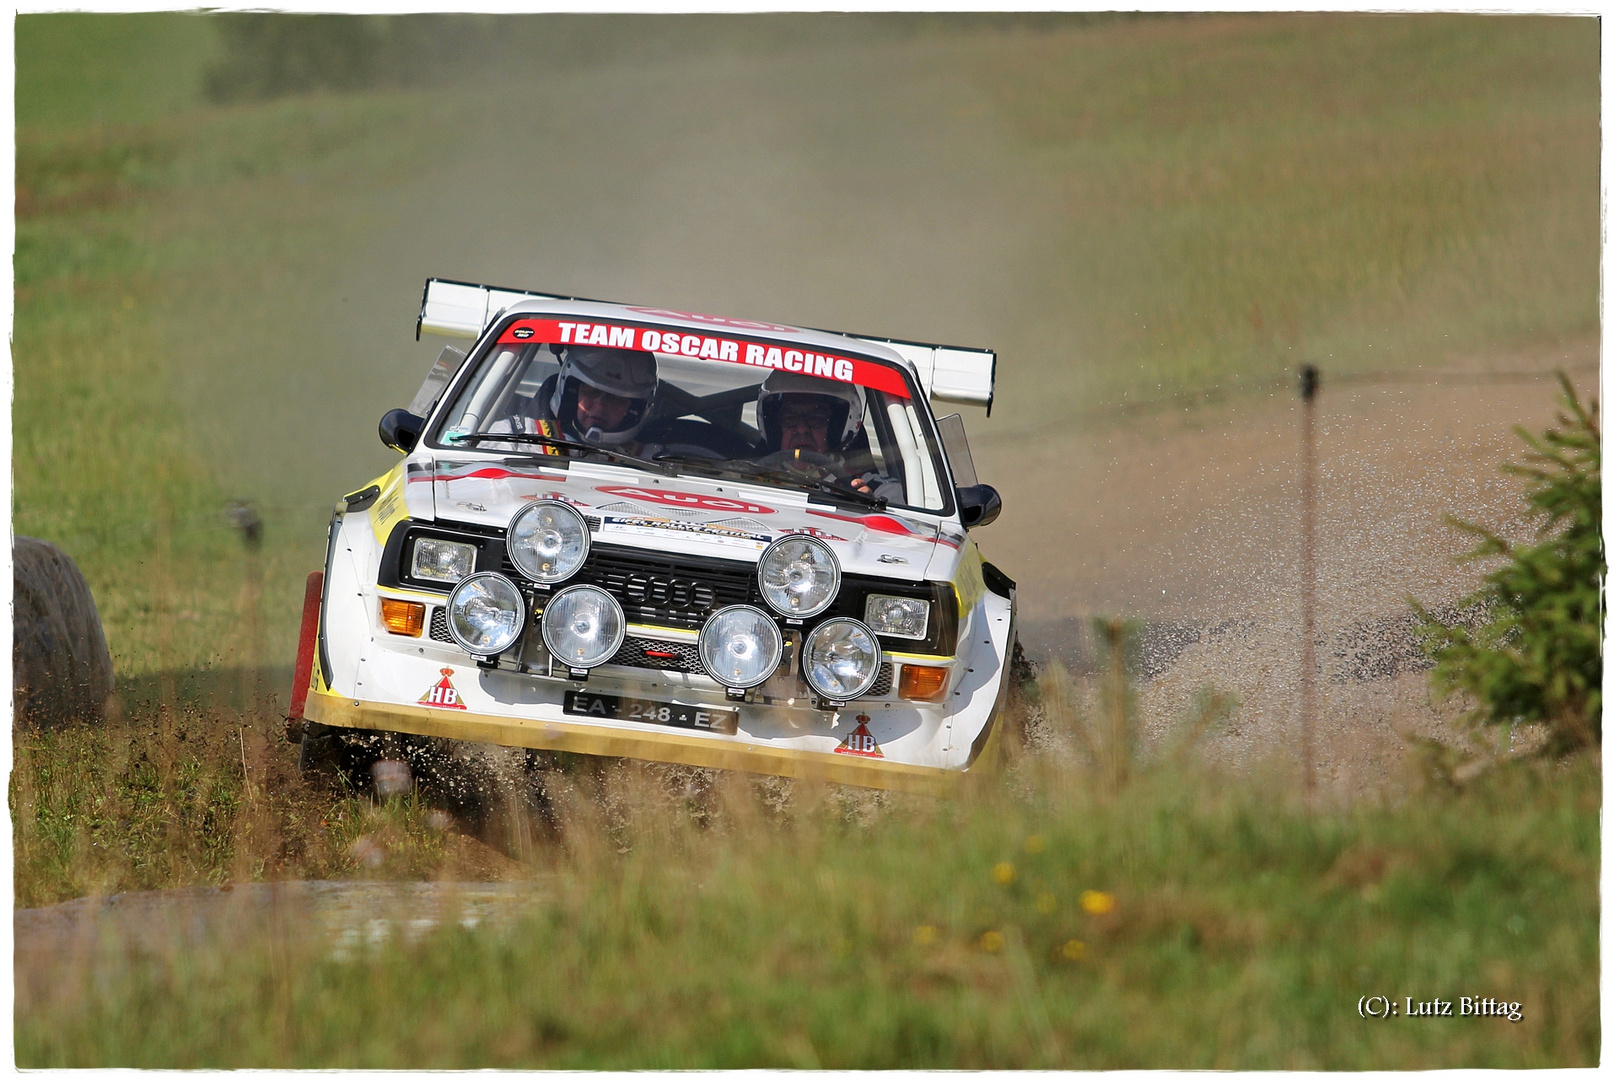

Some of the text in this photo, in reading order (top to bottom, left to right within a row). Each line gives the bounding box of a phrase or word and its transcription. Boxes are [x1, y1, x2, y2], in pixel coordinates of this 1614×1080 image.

[558, 322, 854, 382] TEAM OSCAR RACING
[428, 686, 459, 705] HB
[573, 695, 607, 715] EA
[628, 703, 671, 722] 248
[694, 711, 727, 729] EZ
[847, 733, 876, 753] HB
